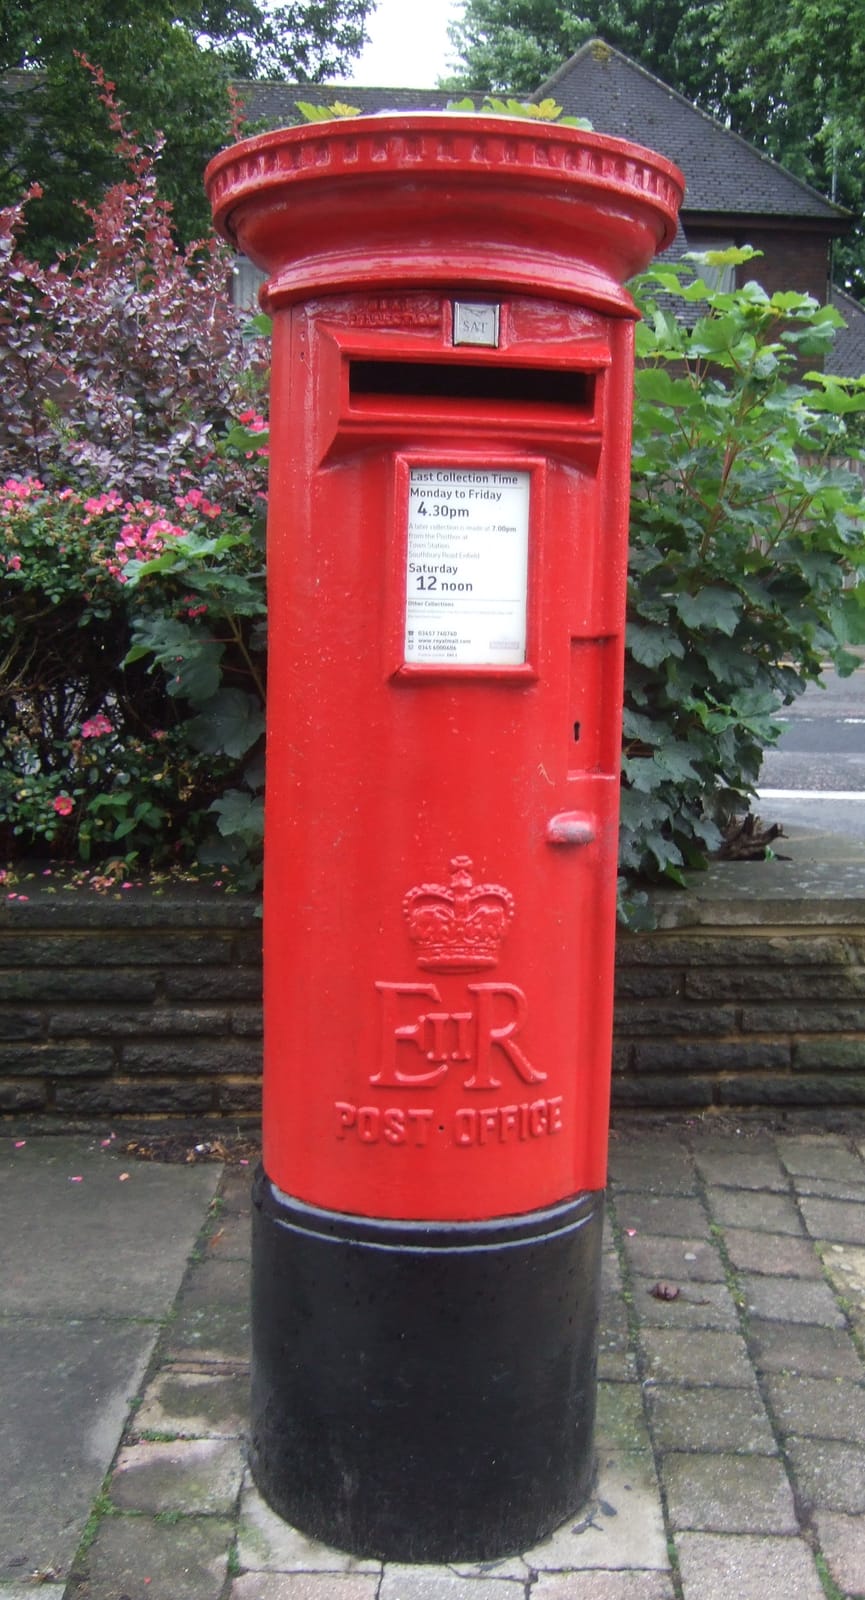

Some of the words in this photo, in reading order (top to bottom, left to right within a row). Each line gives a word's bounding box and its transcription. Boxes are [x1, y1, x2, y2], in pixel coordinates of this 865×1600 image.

[463, 321, 488, 333] SAT
[410, 471, 433, 481] Last
[436, 472, 489, 483] Collection
[492, 474, 518, 484] Time
[410, 487, 452, 500] Monday
[455, 490, 466, 498] to
[468, 489, 502, 502] Friday
[417, 501, 470, 519] 4.30pm
[492, 525, 517, 533] 7.00pm
[409, 563, 458, 576] Saturday
[416, 575, 437, 591] 12
[441, 582, 473, 592] noon
[335, 1101, 434, 1147] POST
[455, 1096, 563, 1146] OFFICE
